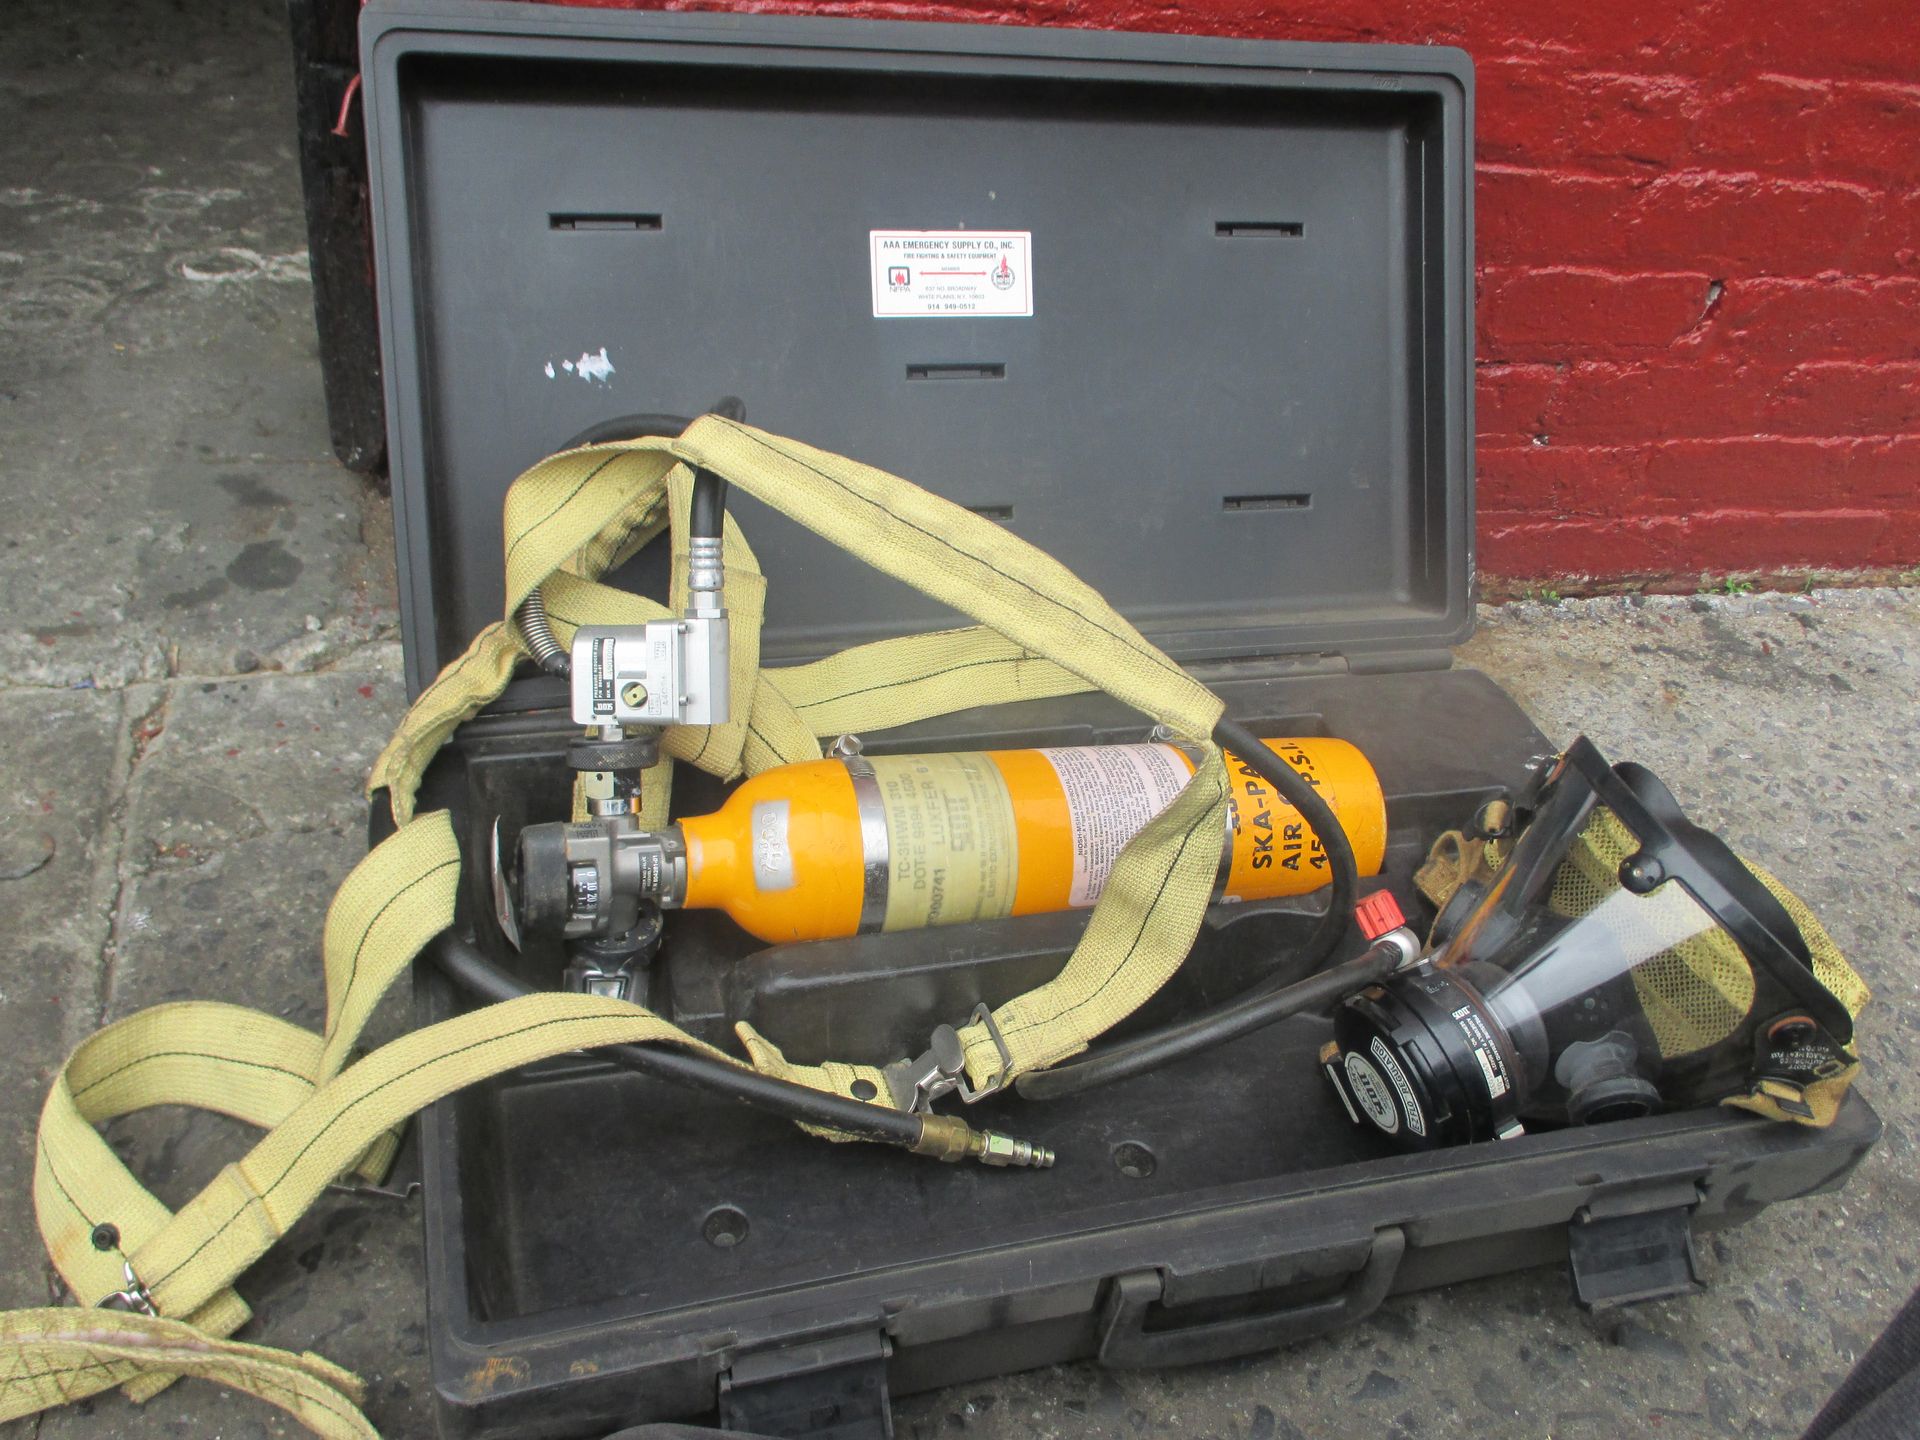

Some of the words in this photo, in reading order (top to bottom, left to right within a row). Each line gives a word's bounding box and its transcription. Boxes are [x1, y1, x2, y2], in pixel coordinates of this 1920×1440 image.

[884, 241, 901, 249] AAA
[903, 241, 949, 249] EMERGENCY
[952, 241, 981, 250] SUPPLY
[1000, 241, 1015, 250] INC.
[886, 781, 901, 800] 310
[1065, 779, 1078, 810] APPROVAL
[920, 781, 944, 845] LUXFER
[894, 806, 910, 881] TC-3HWM
[1075, 812, 1083, 856] NIOSH-MSHA
[1281, 822, 1302, 871] AIR
[913, 845, 926, 890] DOT-E
[587, 881, 598, 891] 10
[587, 893, 598, 903] 20
[1452, 1005, 1471, 1020] SCOTT
[1488, 1039, 1501, 1061] DEMAND
[1374, 1042, 1409, 1094] REGULATOR
